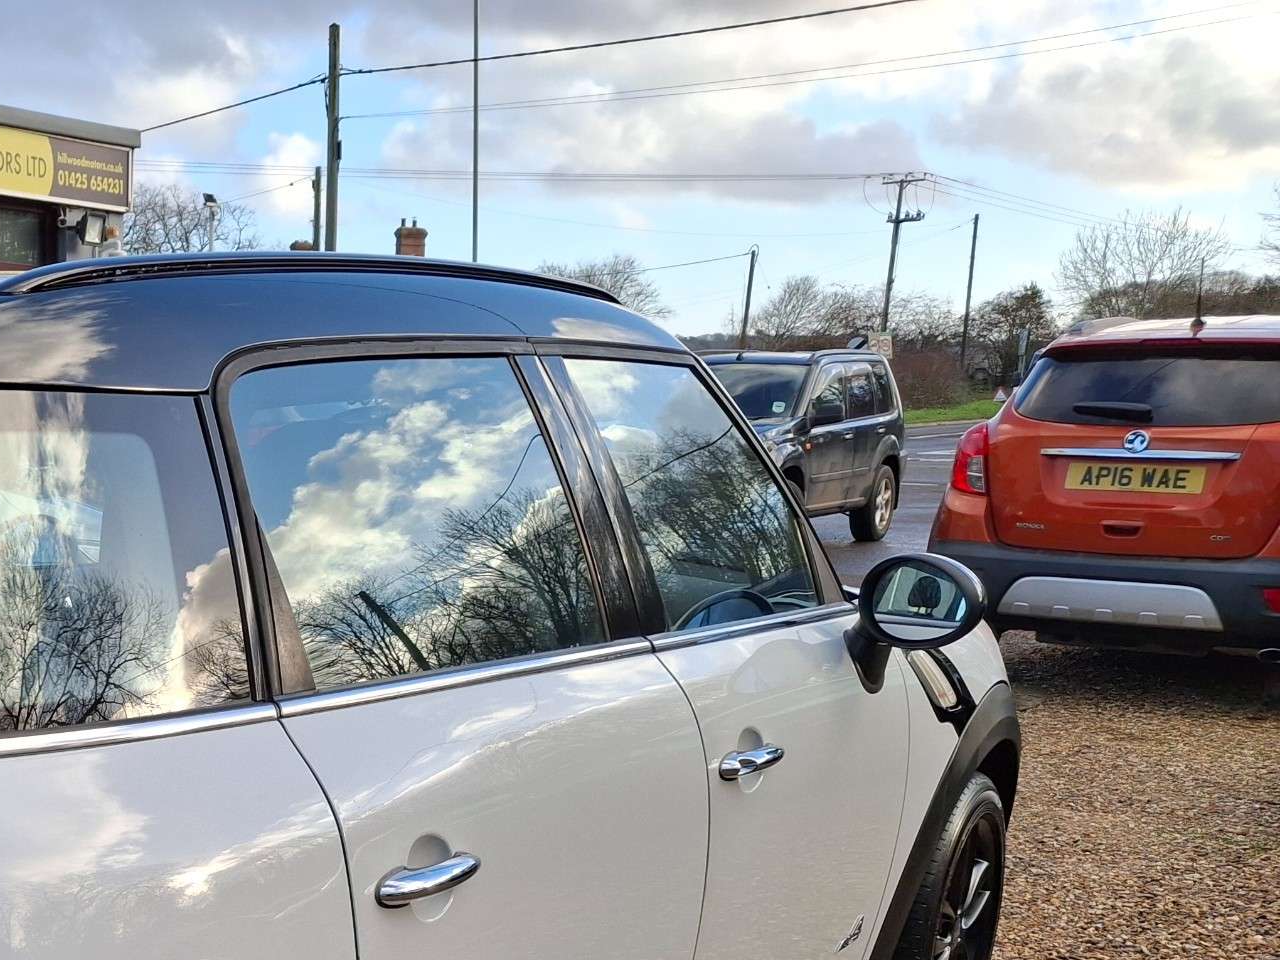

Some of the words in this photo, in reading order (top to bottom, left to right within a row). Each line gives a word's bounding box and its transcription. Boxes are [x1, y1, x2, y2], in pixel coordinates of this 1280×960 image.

[26, 155, 48, 178] LTD
[57, 152, 124, 174] hillwoodmotors.co.uk
[57, 169, 88, 189] 01425
[90, 175, 124, 195] 654231
[1079, 466, 1134, 487] AP16
[1140, 467, 1191, 489] WAE
